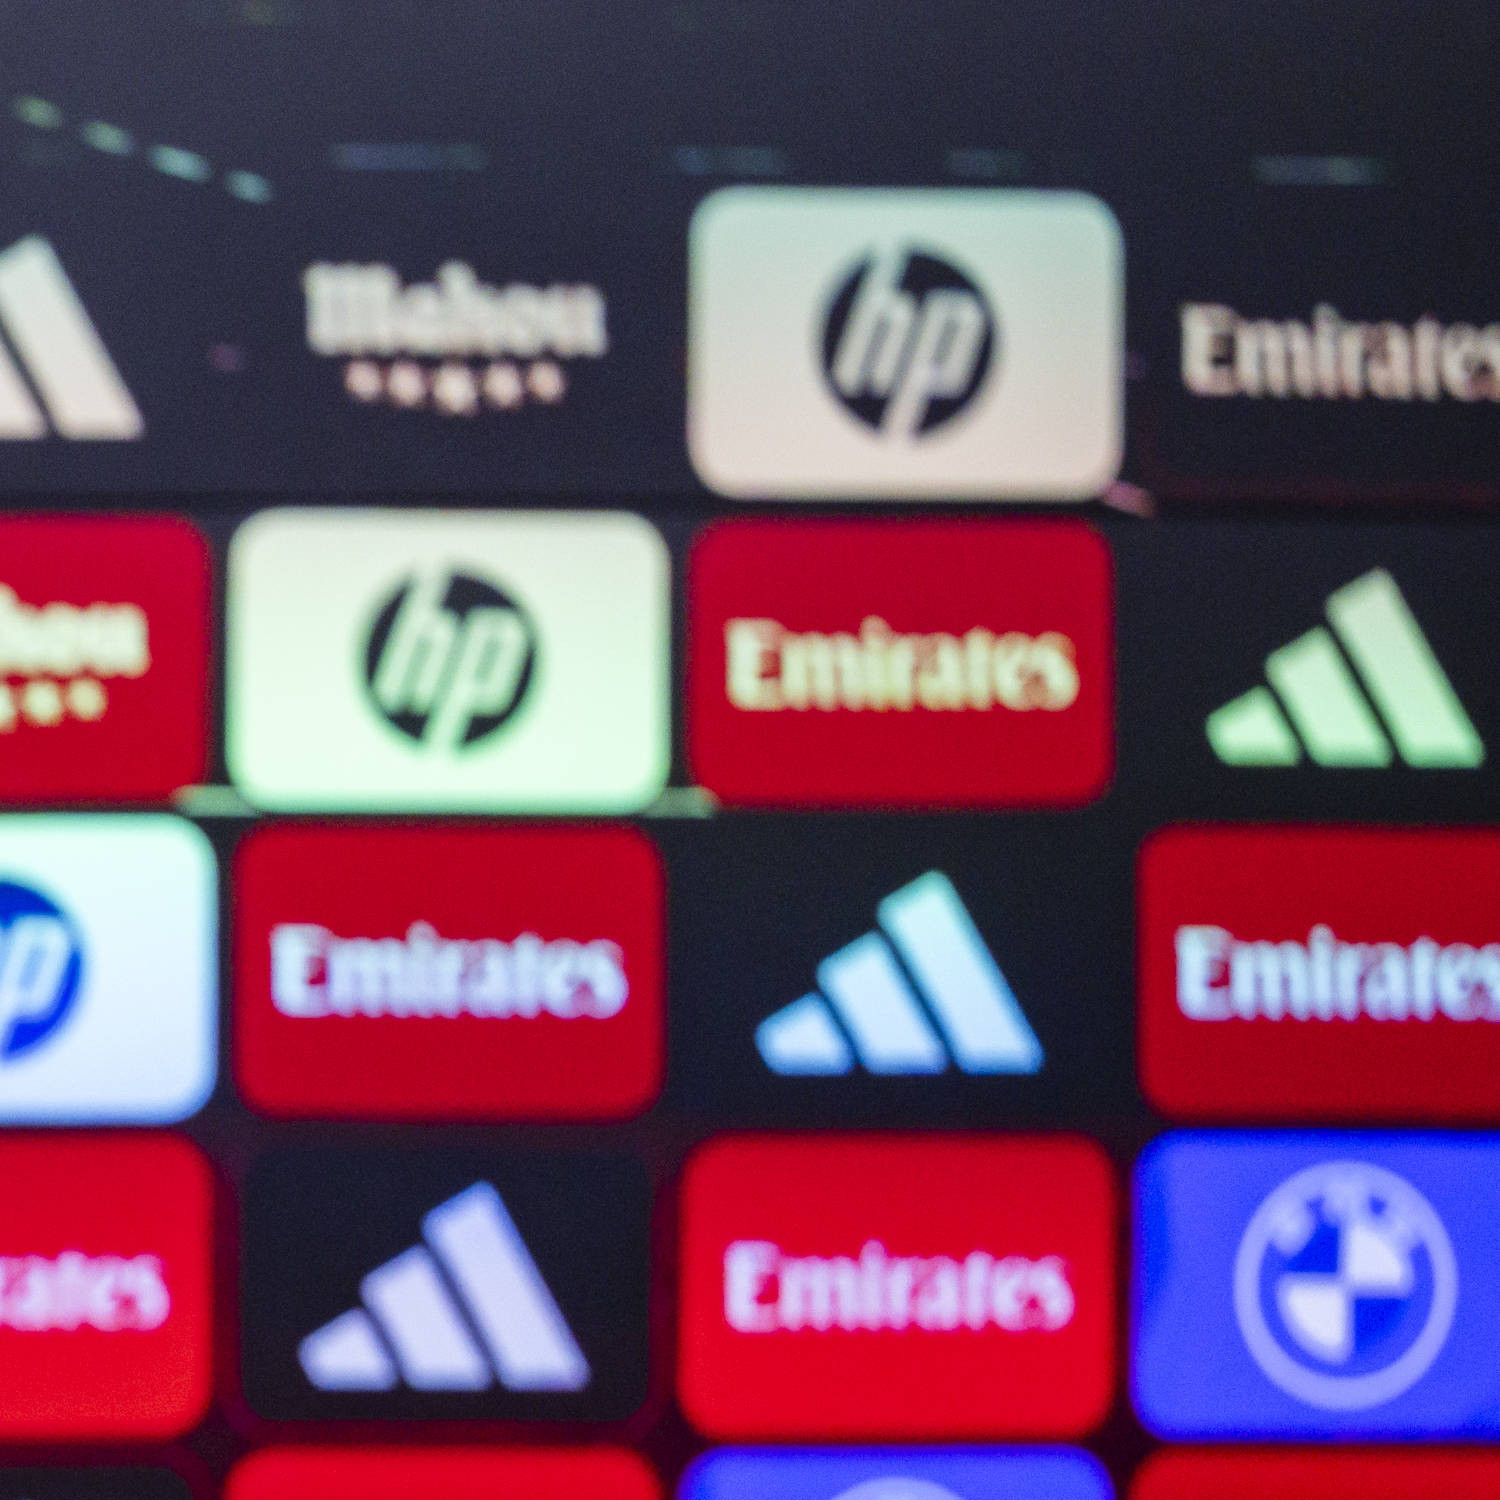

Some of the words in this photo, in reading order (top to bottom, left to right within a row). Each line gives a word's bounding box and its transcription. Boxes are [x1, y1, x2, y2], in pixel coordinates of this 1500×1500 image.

[835, 249, 985, 438] hp
[378, 570, 524, 747] hp
[727, 618, 1078, 709] Emirates
[271, 924, 626, 1016] Emirates
[725, 1243, 1072, 1330] Emirates
